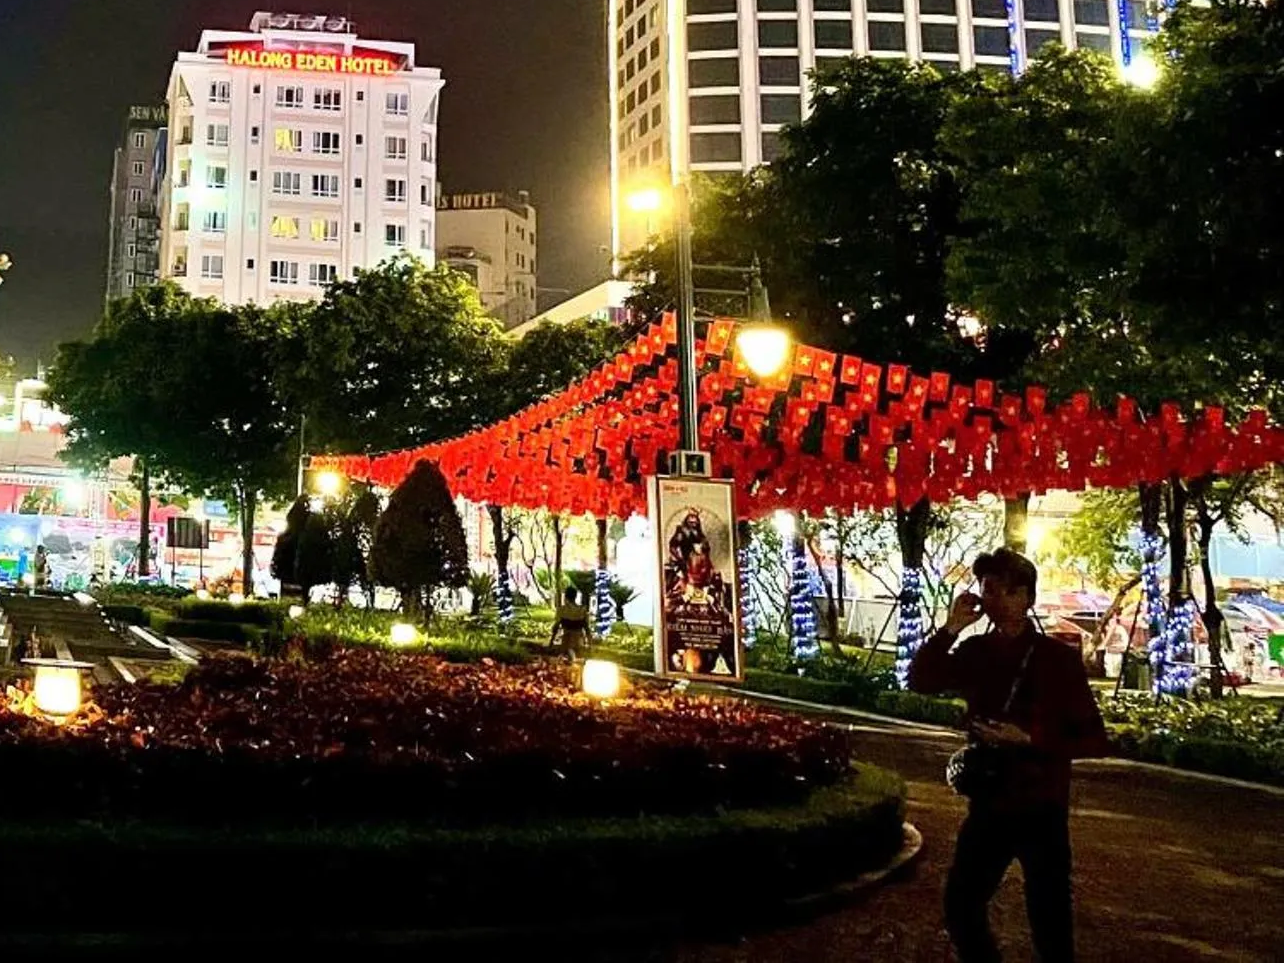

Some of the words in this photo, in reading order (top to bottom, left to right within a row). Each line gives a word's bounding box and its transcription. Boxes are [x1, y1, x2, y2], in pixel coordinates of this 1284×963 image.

[227, 49, 292, 69] HALONG
[296, 53, 336, 71] EDEN
[341, 56, 393, 74] HOTEL
[129, 106, 150, 120] SEN
